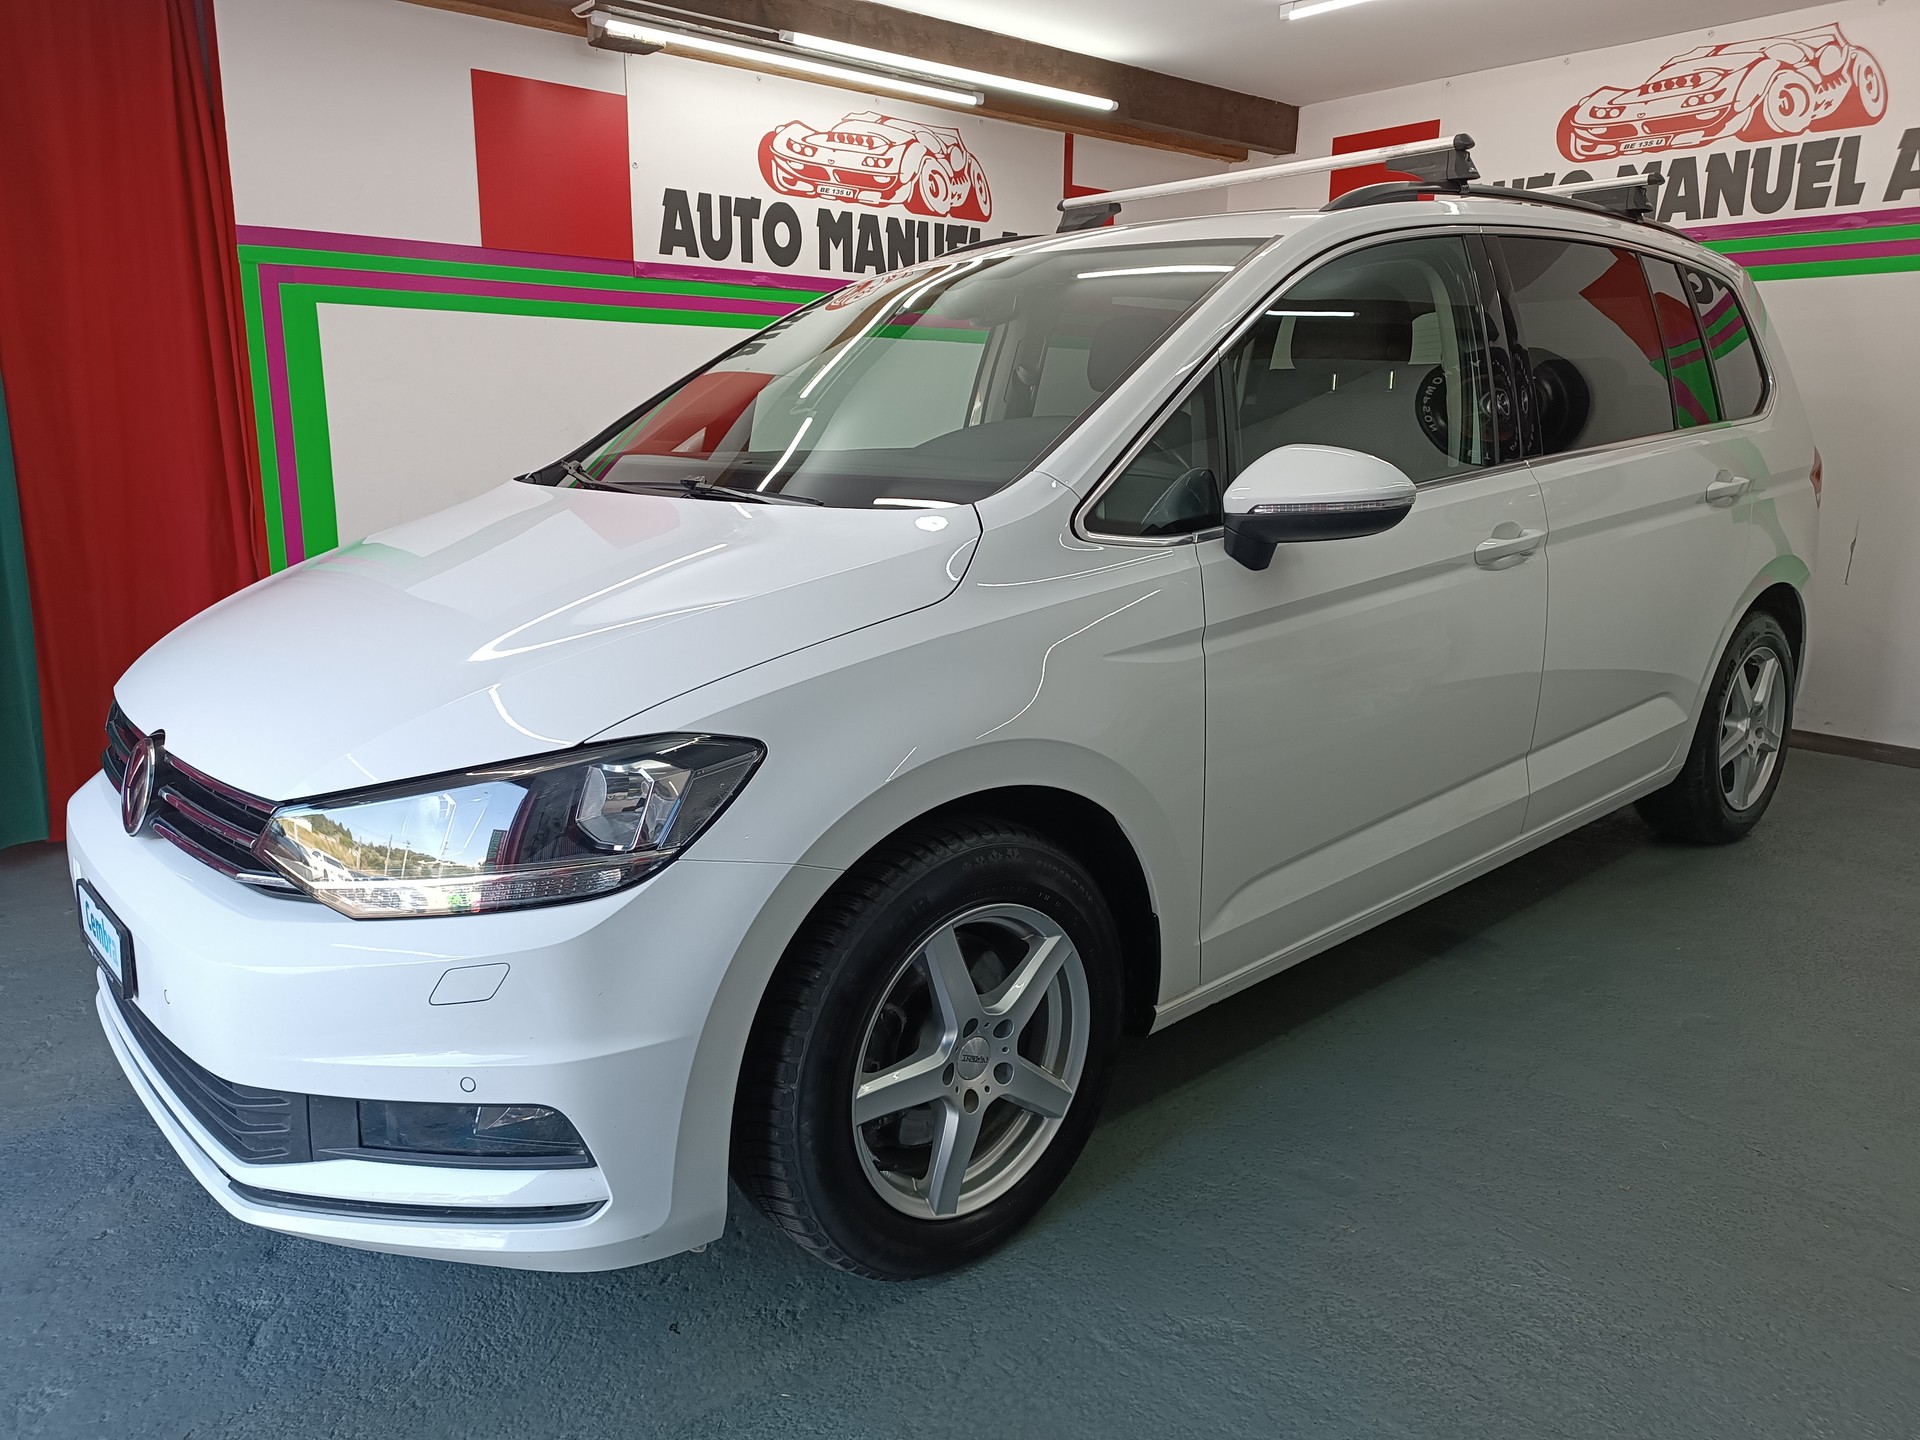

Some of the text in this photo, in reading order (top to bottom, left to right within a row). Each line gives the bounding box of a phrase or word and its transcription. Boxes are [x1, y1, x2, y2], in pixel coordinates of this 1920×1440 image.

[1638, 140, 1654, 148] 135
[659, 188, 980, 275] AUTO MANU
[85, 900, 119, 968] Cembra
